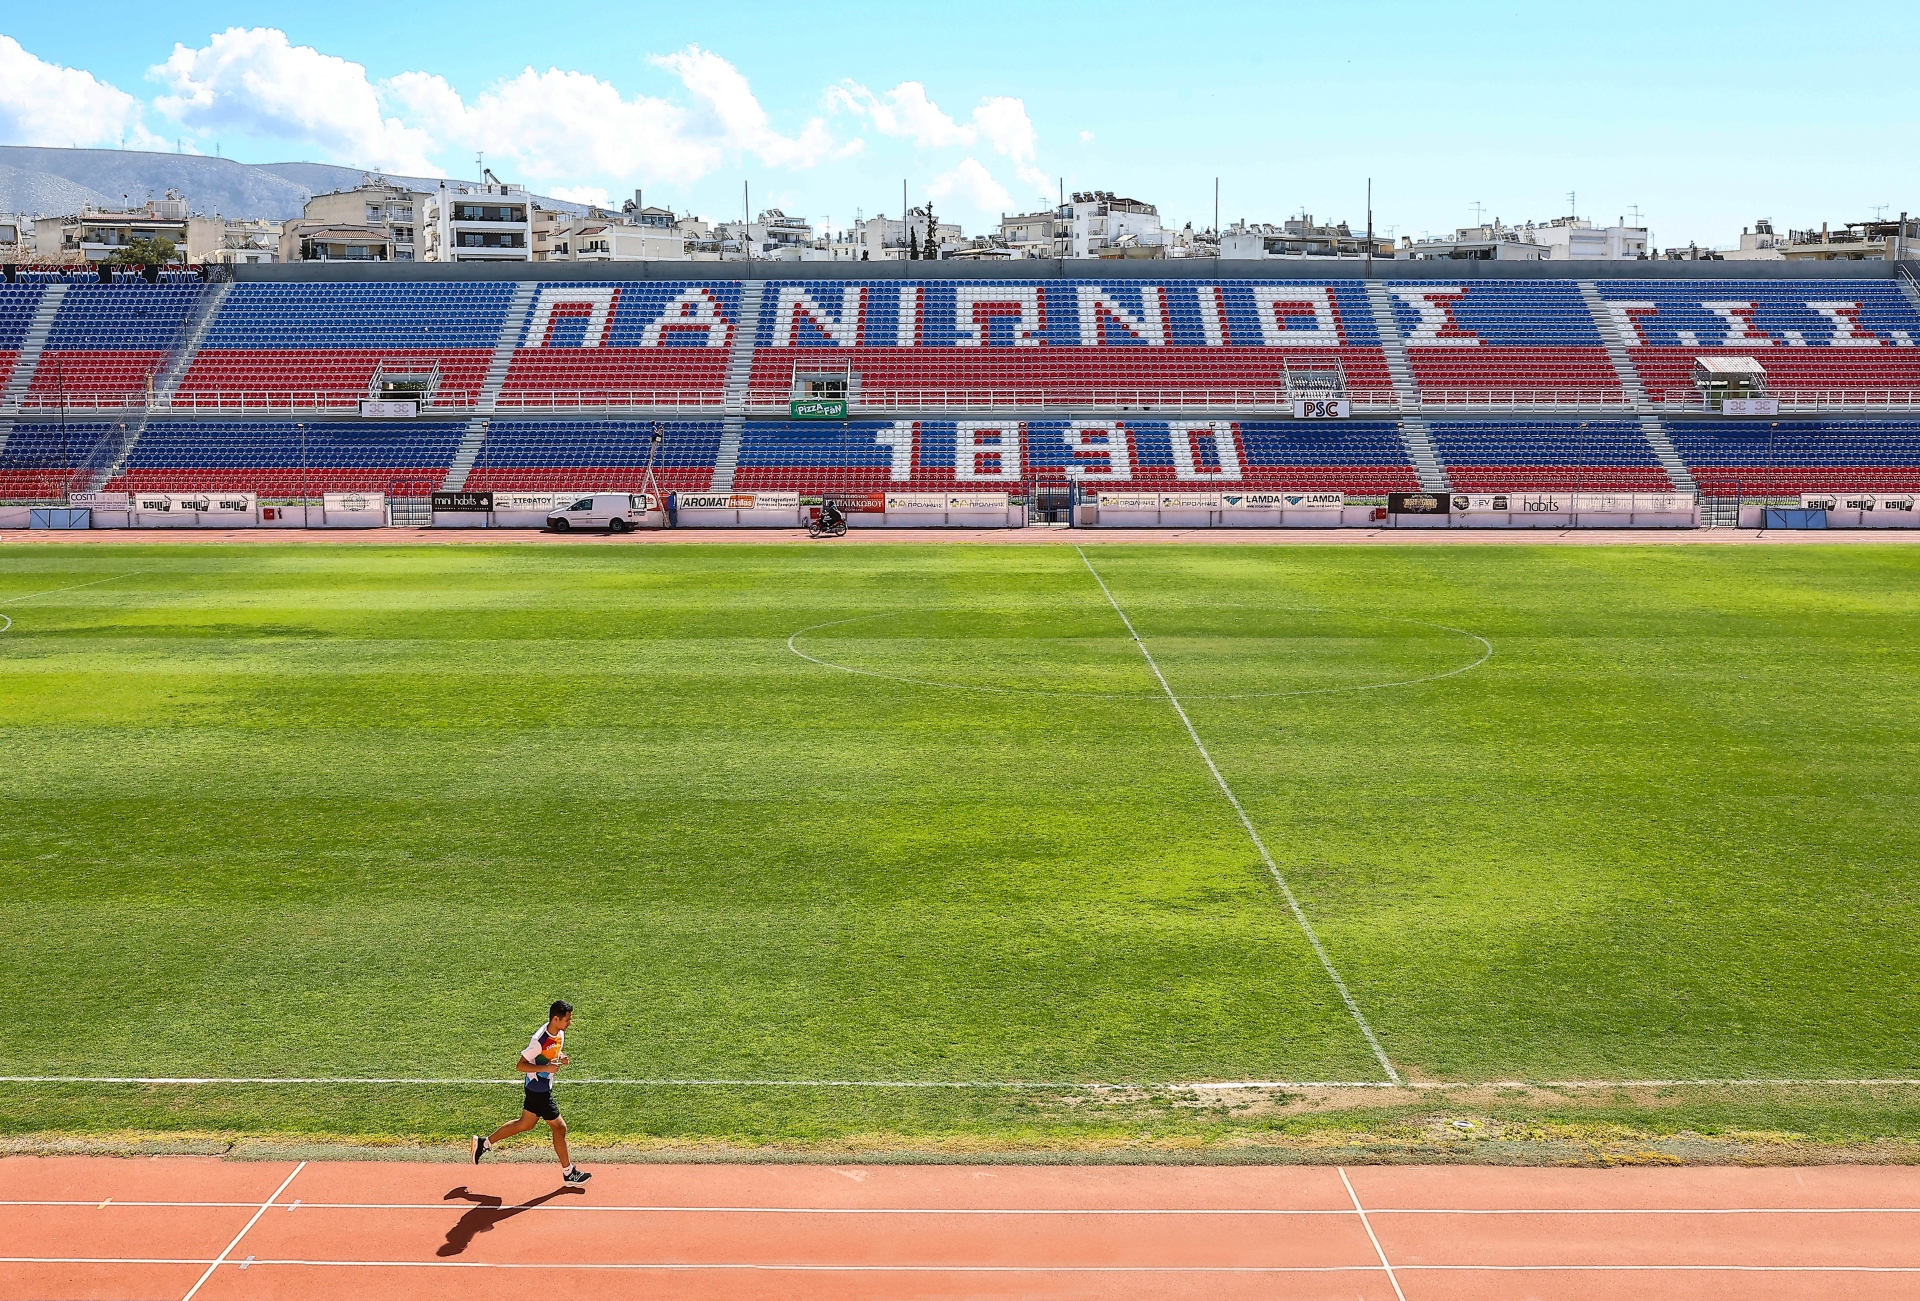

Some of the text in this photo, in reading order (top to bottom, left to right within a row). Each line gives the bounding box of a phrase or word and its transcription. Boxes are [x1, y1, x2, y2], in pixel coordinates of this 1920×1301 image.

[1303, 401, 1339, 417] PSC
[875, 421, 1244, 481] 1890
[434, 494, 477, 506] mini habits
[682, 497, 729, 508] AROMAT
[1246, 495, 1281, 503] LAMDA
[1306, 495, 1341, 503] LAMDA
[1523, 494, 1559, 512] habits
